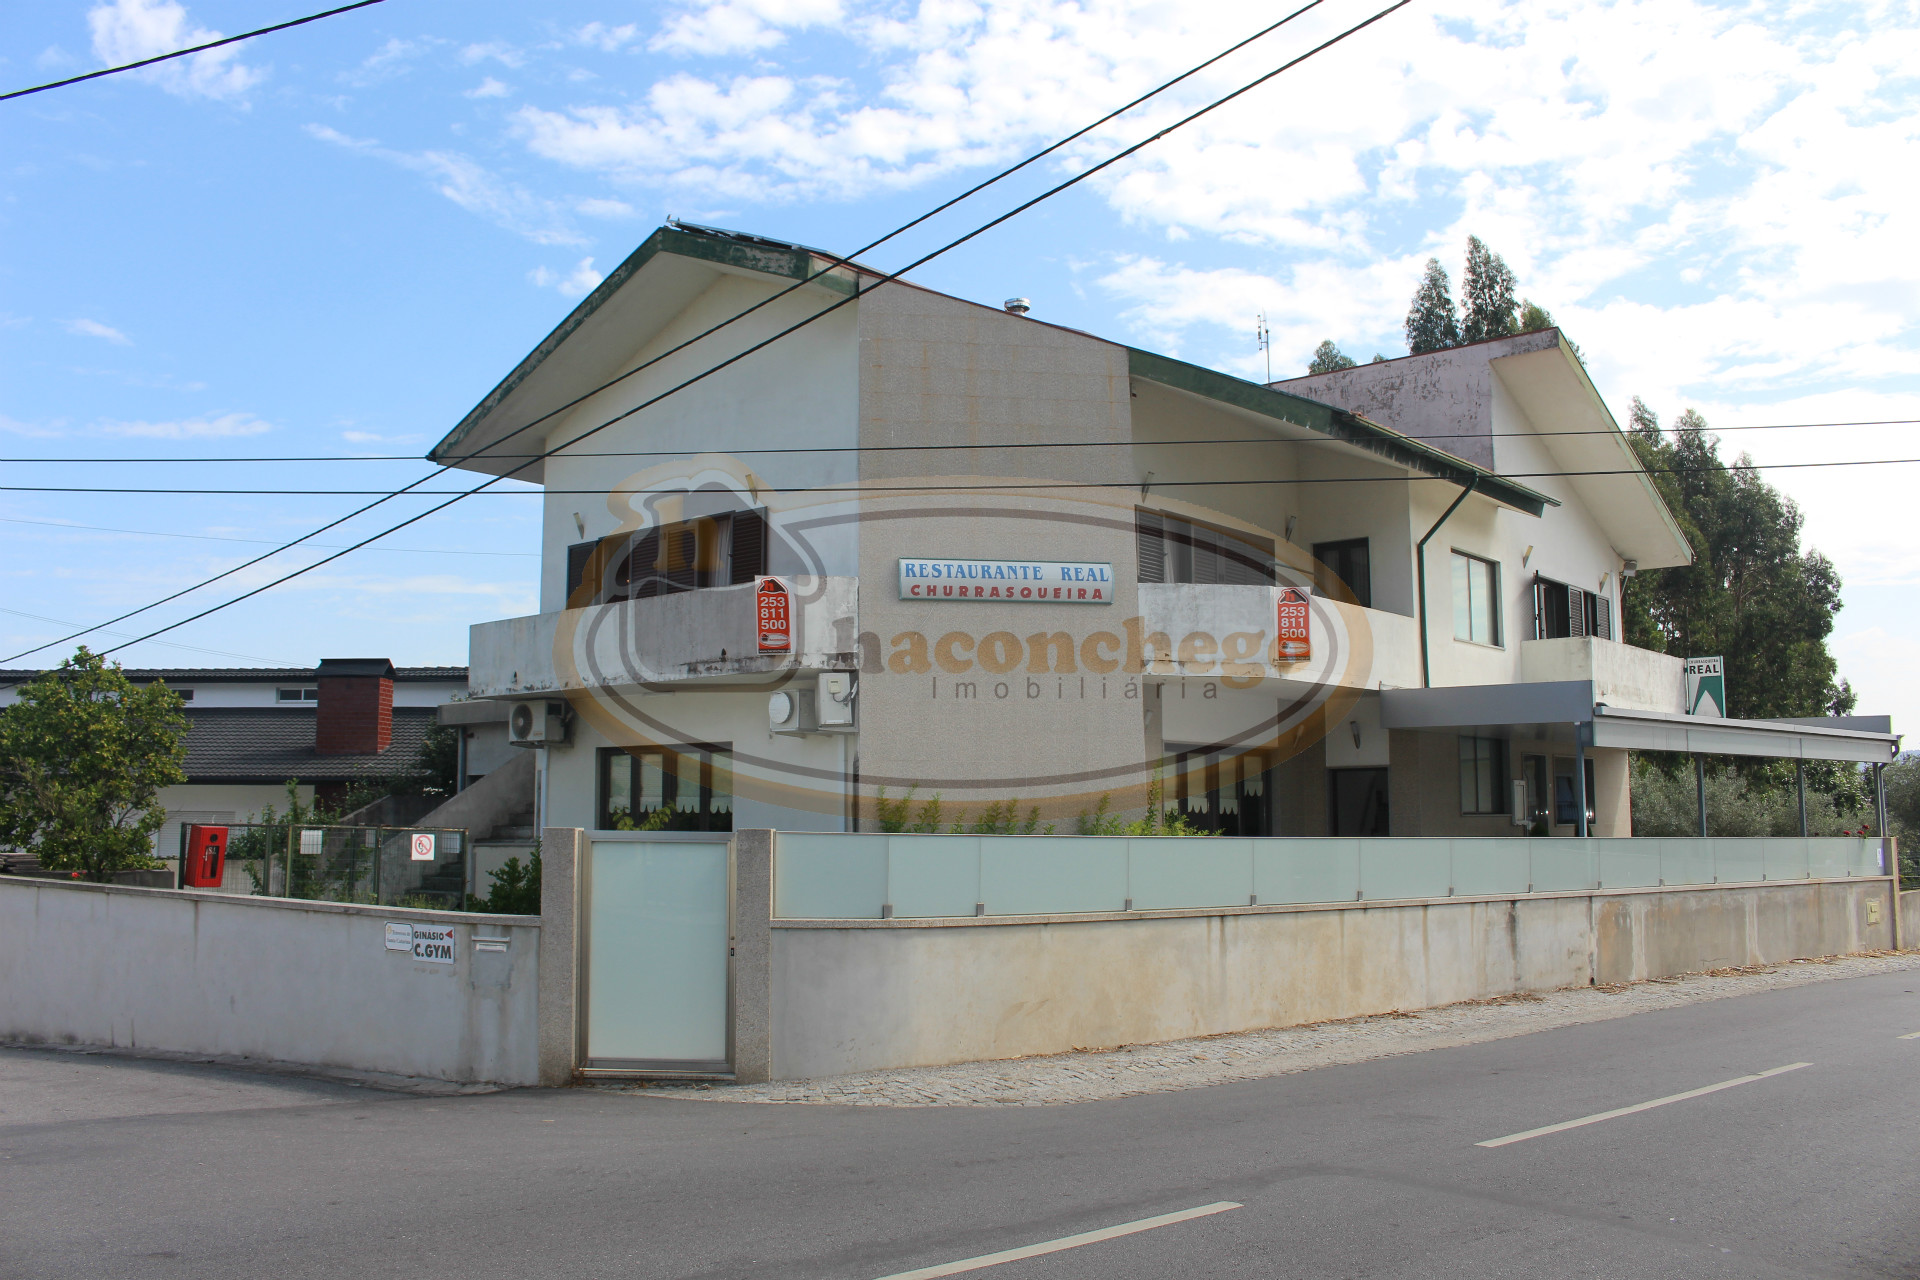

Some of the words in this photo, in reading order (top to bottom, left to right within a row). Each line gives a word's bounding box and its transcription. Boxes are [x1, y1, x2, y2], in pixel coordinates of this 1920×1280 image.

[904, 563, 1044, 581] RESTAURANTE
[1060, 566, 1110, 582] REAL
[910, 584, 1103, 600] CHURRASQUEIRA
[760, 596, 786, 607] 253
[760, 608, 785, 618] 811
[1280, 606, 1306, 617] 253
[761, 619, 787, 630] 500
[1281, 617, 1304, 627] 811
[1281, 628, 1306, 638] 500
[1688, 664, 1720, 675] REAL
[414, 929, 445, 941] GINÁSIO
[414, 943, 452, 959] C.GYM
